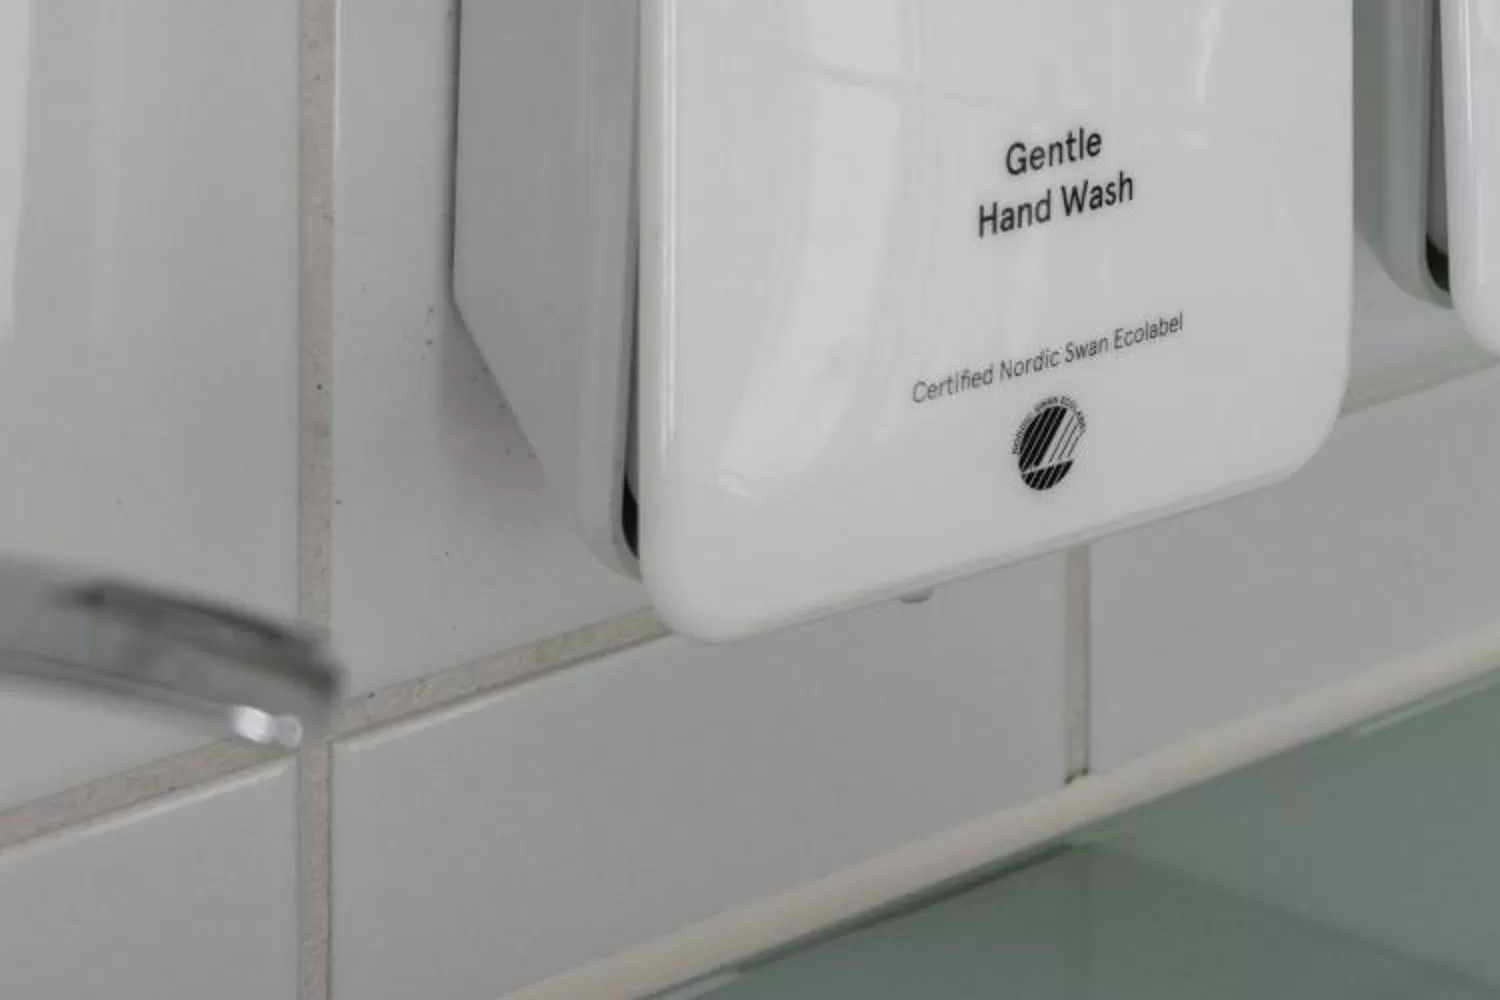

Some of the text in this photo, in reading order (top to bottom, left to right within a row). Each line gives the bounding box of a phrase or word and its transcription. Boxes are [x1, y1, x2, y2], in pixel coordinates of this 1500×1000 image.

[1004, 126, 1103, 176] Gentle
[978, 169, 1134, 238] Hand Wash
[911, 311, 1184, 404] Certified Nordic Swan Ecolabel
